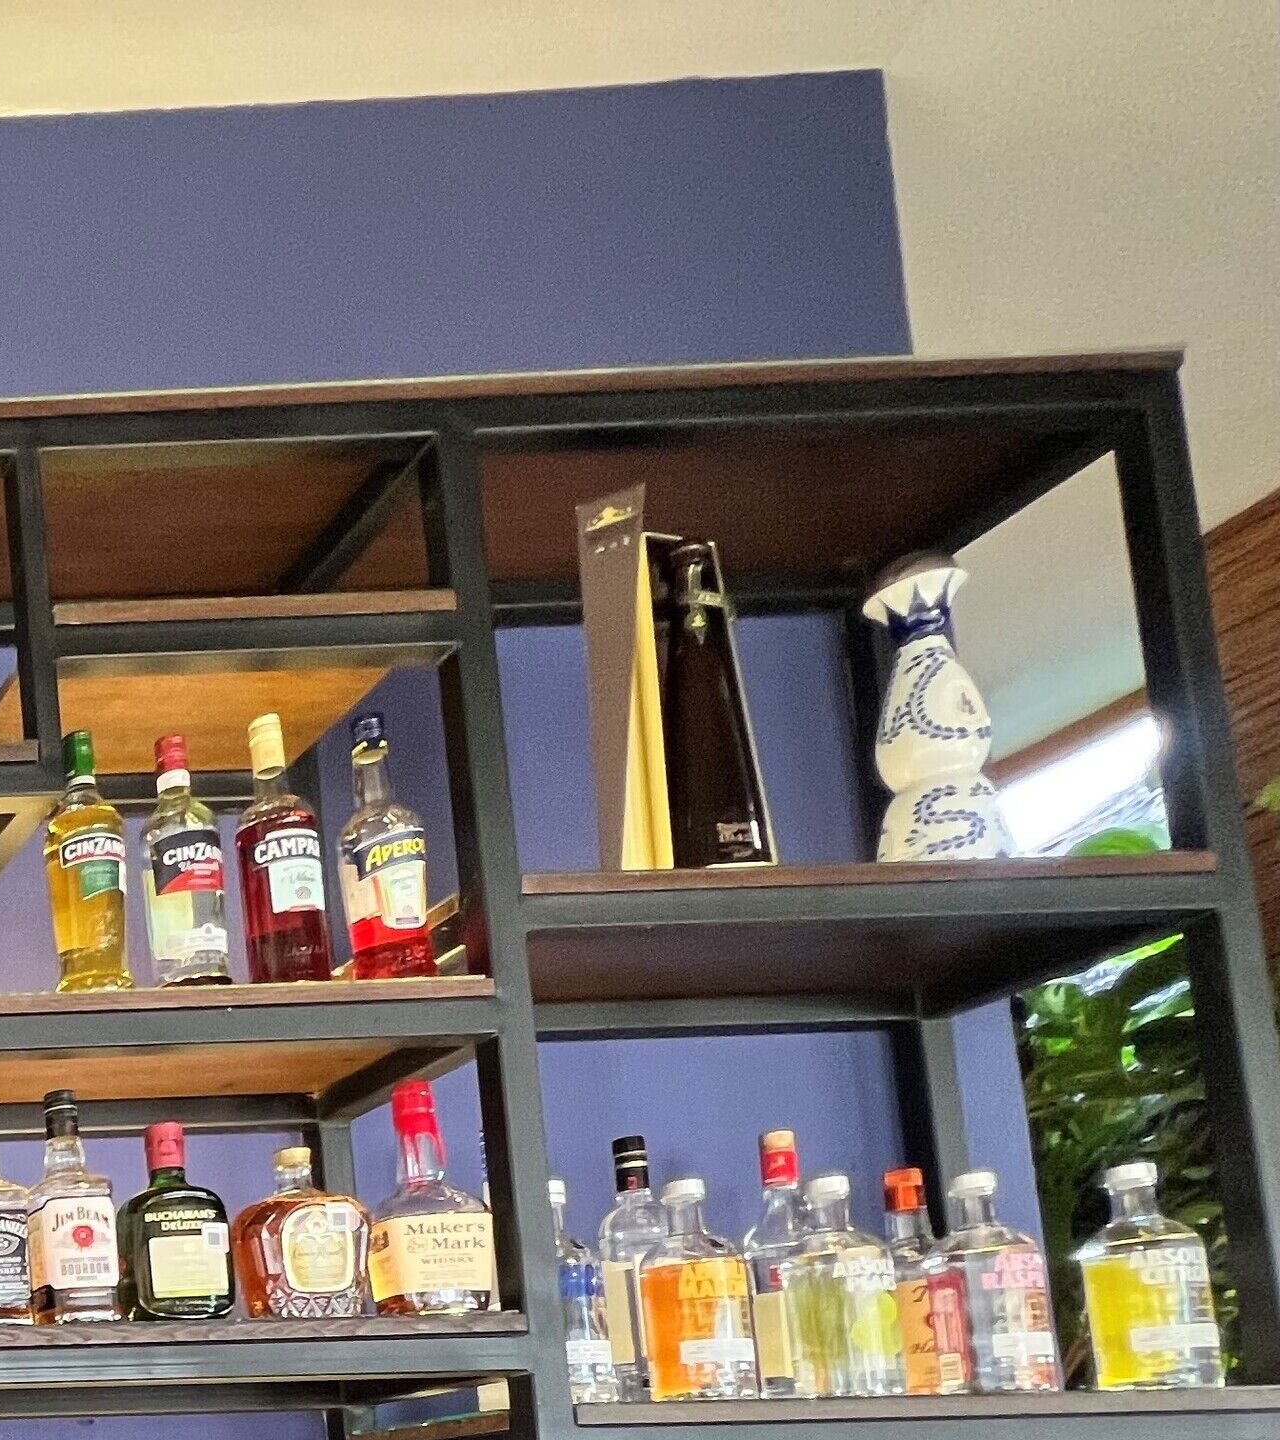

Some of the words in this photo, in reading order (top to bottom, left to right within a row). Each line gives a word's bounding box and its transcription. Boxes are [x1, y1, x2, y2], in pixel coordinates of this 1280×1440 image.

[52, 1211, 75, 1232] JIM
[77, 1206, 110, 1229] BEAM
[404, 1221, 486, 1237] Maker's
[431, 1237, 486, 1250] Mark
[60, 1261, 111, 1276] BOURBON
